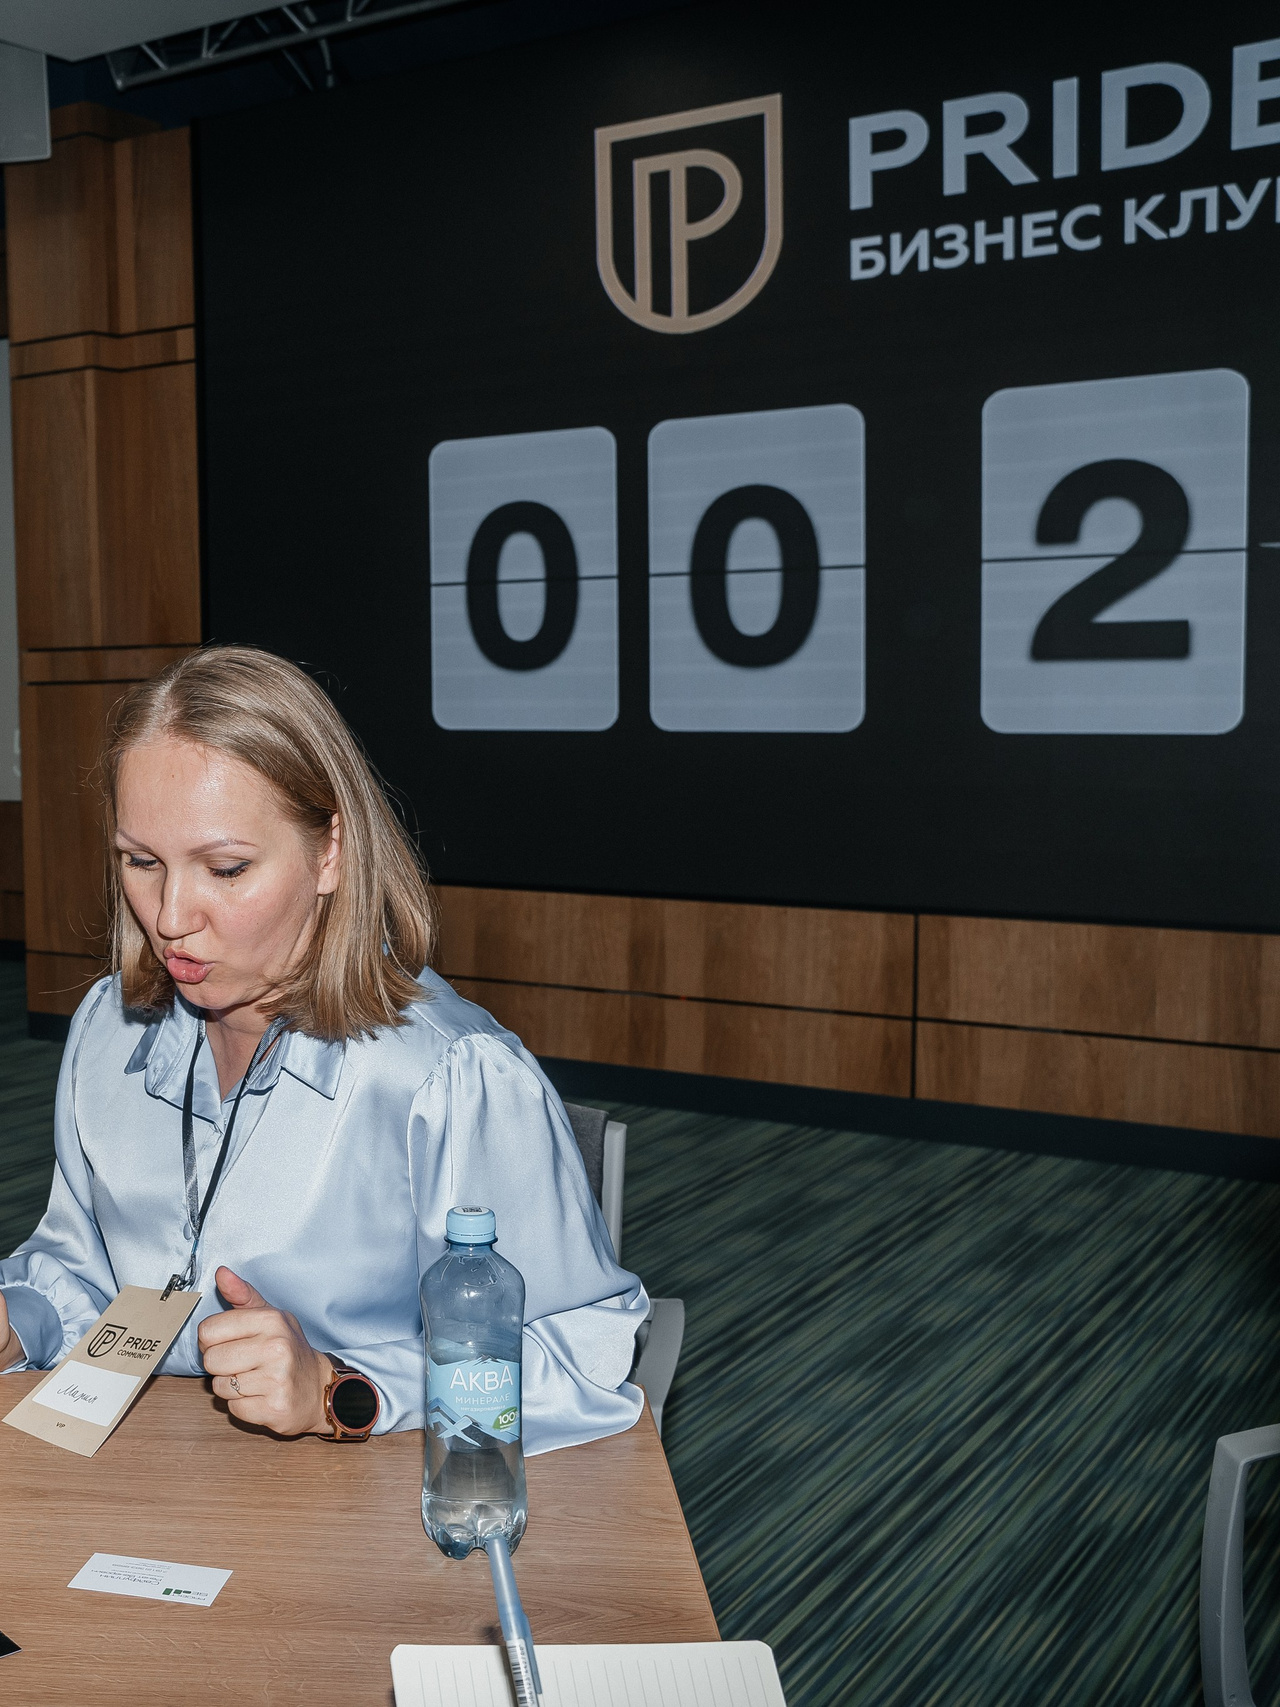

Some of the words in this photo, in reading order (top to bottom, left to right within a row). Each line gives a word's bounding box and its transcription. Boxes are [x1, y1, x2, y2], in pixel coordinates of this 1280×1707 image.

[848, 37, 1280, 211] PRIDE
[849, 203, 1102, 281] БИЗНЕС
[1123, 176, 1280, 245] КЛУ
[122, 1336, 162, 1352] PRIDE
[116, 1349, 152, 1360] COMMUNITY
[450, 1365, 514, 1394] АКВА
[455, 1392, 511, 1405] МИНЕРАЛЕ
[55, 1421, 66, 1429] VIP
